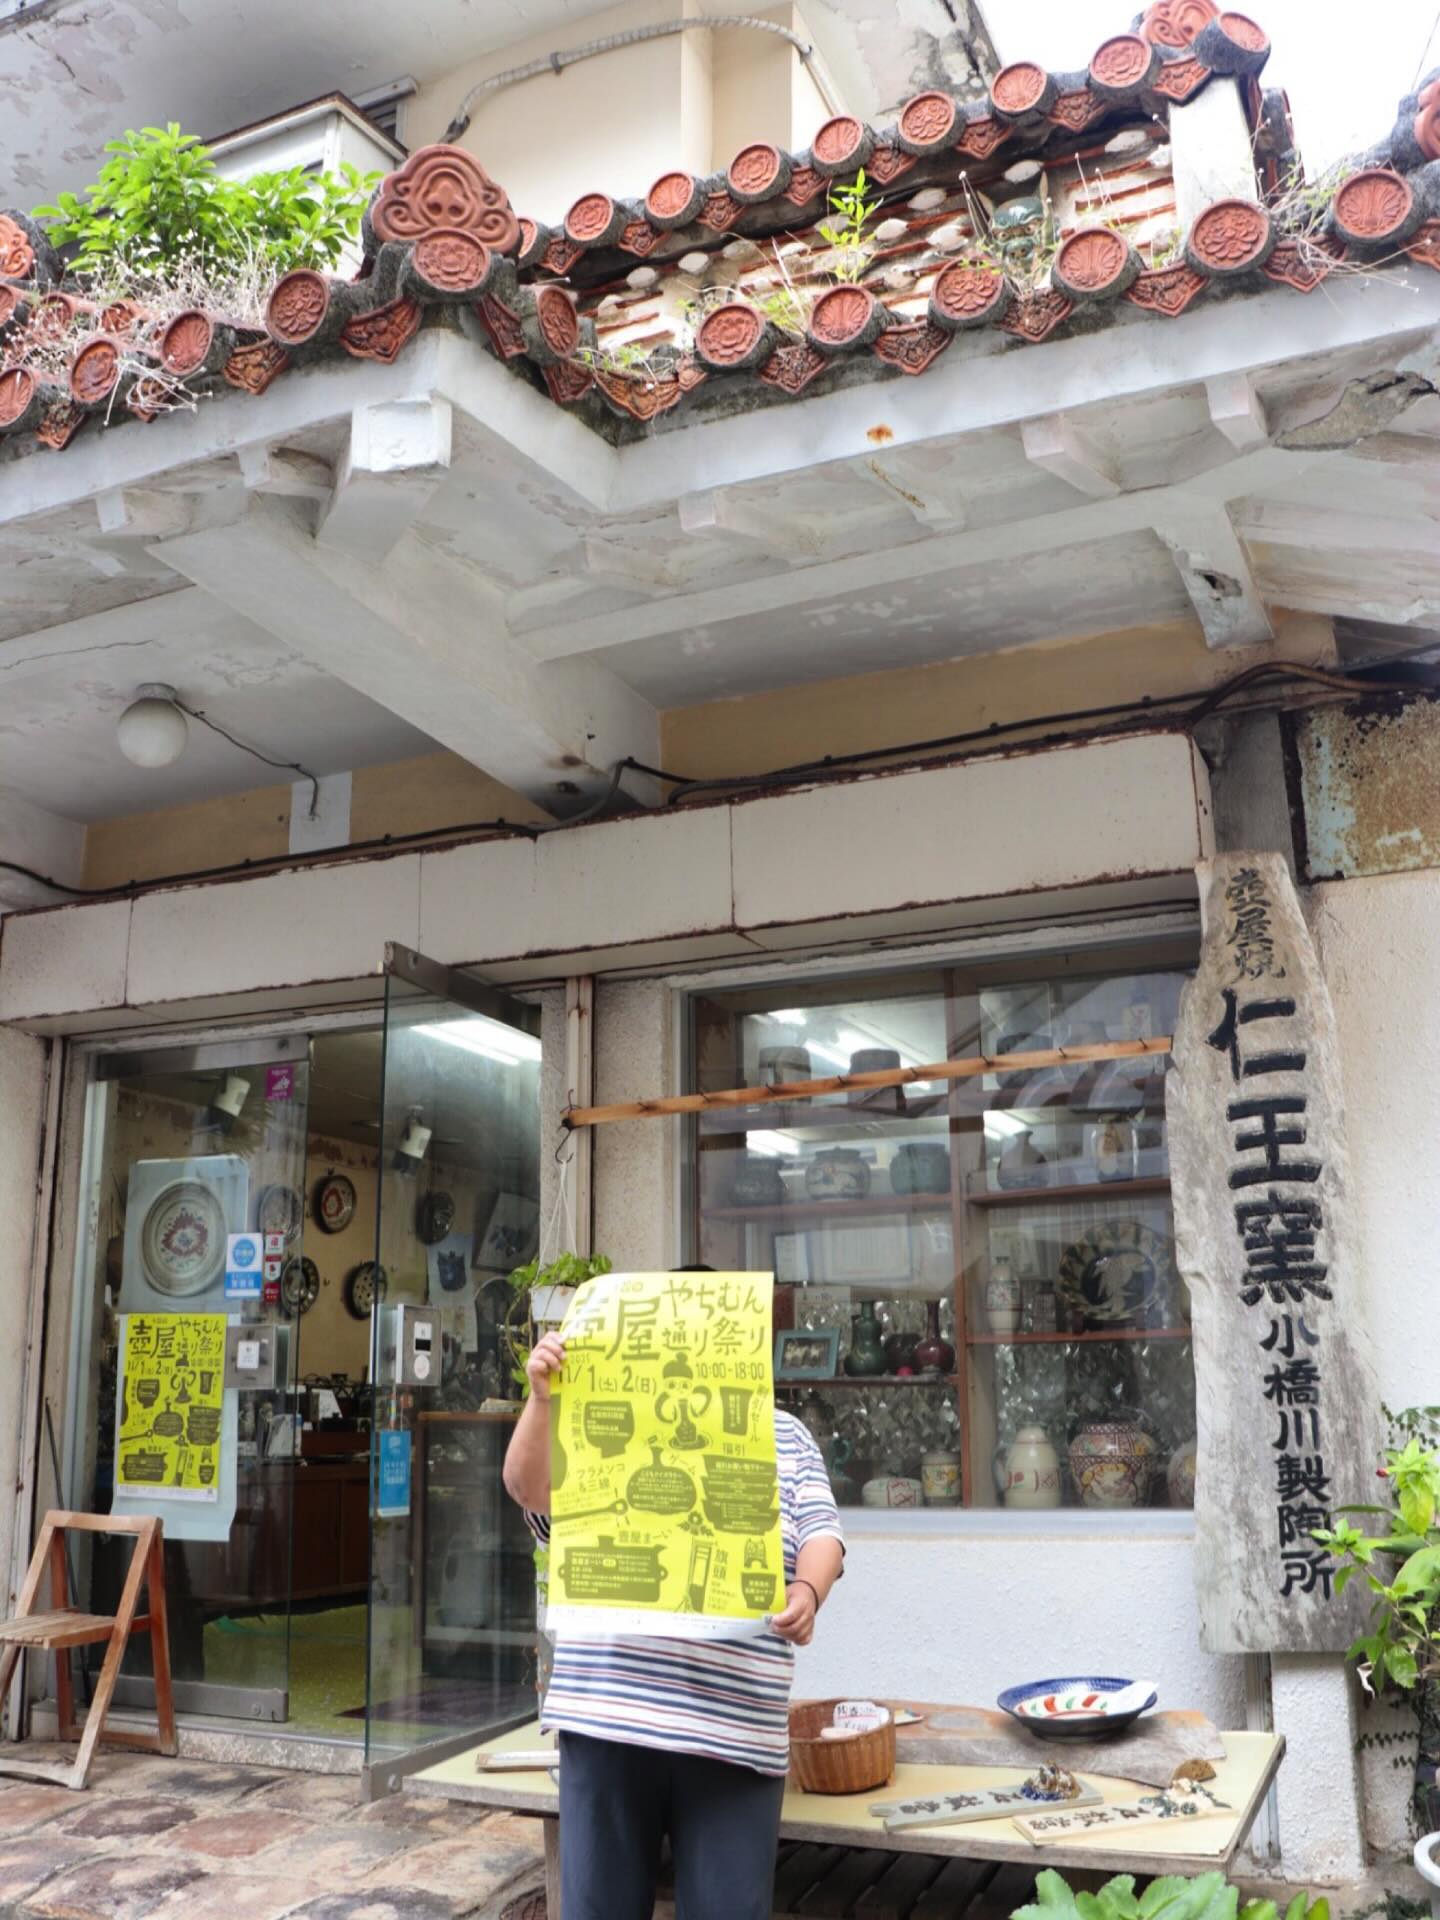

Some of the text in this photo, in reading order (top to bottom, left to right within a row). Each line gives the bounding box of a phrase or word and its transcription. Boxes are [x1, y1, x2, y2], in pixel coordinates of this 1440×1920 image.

[1207, 987, 1333, 1305] 仁王窯
[662, 1280, 765, 1319] やちむん
[176, 1317, 222, 1337] やちむん
[662, 1317, 765, 1357] 通り祭り
[695, 1362, 765, 1380] 10:00-18:00
[1259, 1311, 1336, 1601] 小橋川製陶所
